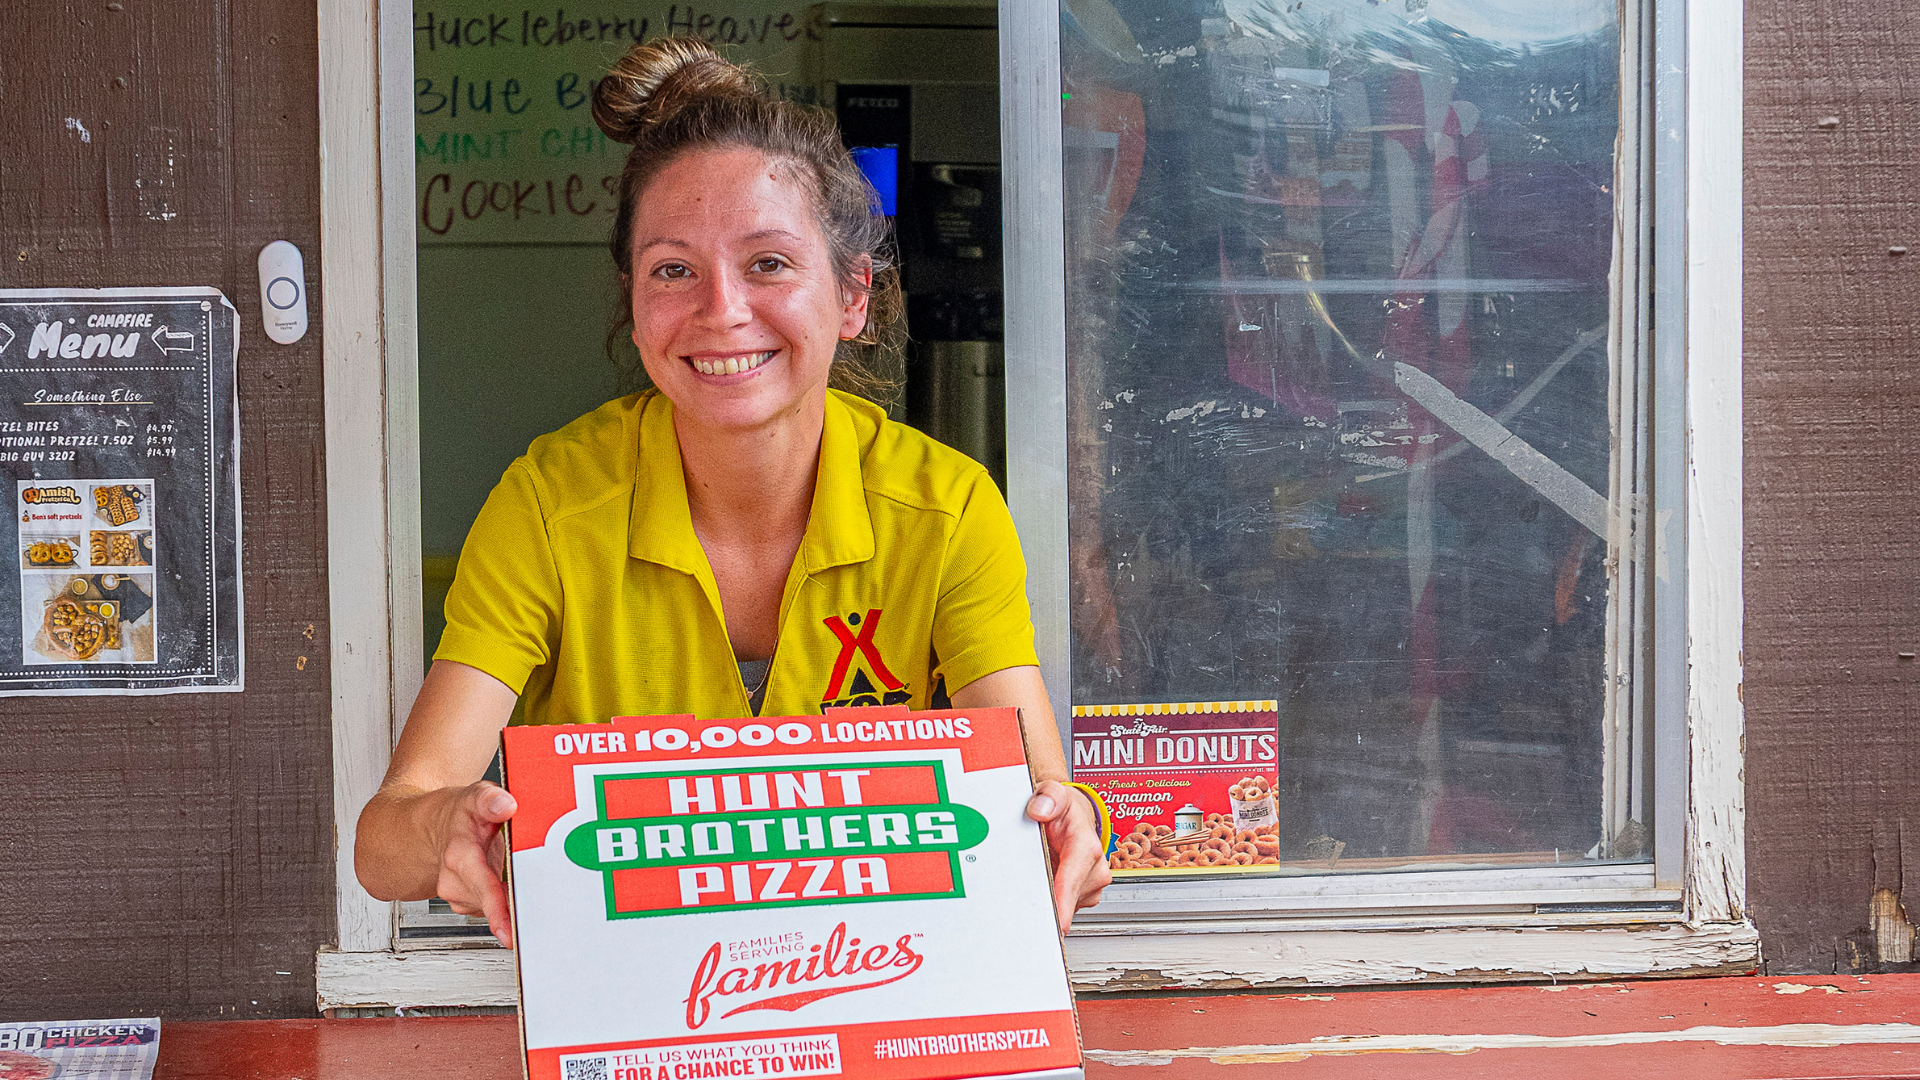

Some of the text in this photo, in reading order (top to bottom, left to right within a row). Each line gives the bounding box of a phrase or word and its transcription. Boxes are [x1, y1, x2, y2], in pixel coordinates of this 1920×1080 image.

[413, 9, 649, 50] Huckleberry
[415, 128, 522, 164] MINT
[87, 313, 154, 328] CAMPFIRE
[27, 321, 141, 359] Menu
[33, 389, 143, 405] Something Else
[0, 421, 59, 432] ZEL BITES
[146, 424, 173, 433] $4.99
[50, 435, 99, 447] PRETZEL
[146, 436, 173, 446] $5.99
[0, 452, 19, 462] BIG
[22, 451, 45, 462] GUY
[146, 447, 176, 458] $14.99
[34, 487, 80, 503] Amish
[59, 513, 82, 521] pretzels
[553, 731, 627, 755] OVER
[820, 717, 974, 743] LOCATIONS
[1074, 734, 1275, 766] MINI DONUTS
[668, 769, 870, 814] HUNT
[1108, 779, 1138, 789] Fresh
[1145, 779, 1191, 788] Delicious
[1097, 790, 1173, 803] Cinnamon
[1115, 803, 1163, 821] Sugar
[1175, 822, 1197, 830] SUGAR
[596, 811, 959, 863] BROTHERS
[678, 857, 890, 906] PIZZA
[728, 931, 804, 952] FAMILIES
[730, 942, 804, 962] SERVING
[682, 921, 924, 1030] families
[47, 1025, 144, 1039] CHICKEN
[46, 1035, 142, 1049] PIZZA
[874, 1028, 1050, 1060] #HUNTBROTHERSPIZZA
[613, 1039, 832, 1067] TELL US WHAT YOU THINK
[613, 1052, 836, 1080] FOR A CHANCE TO WIN!
